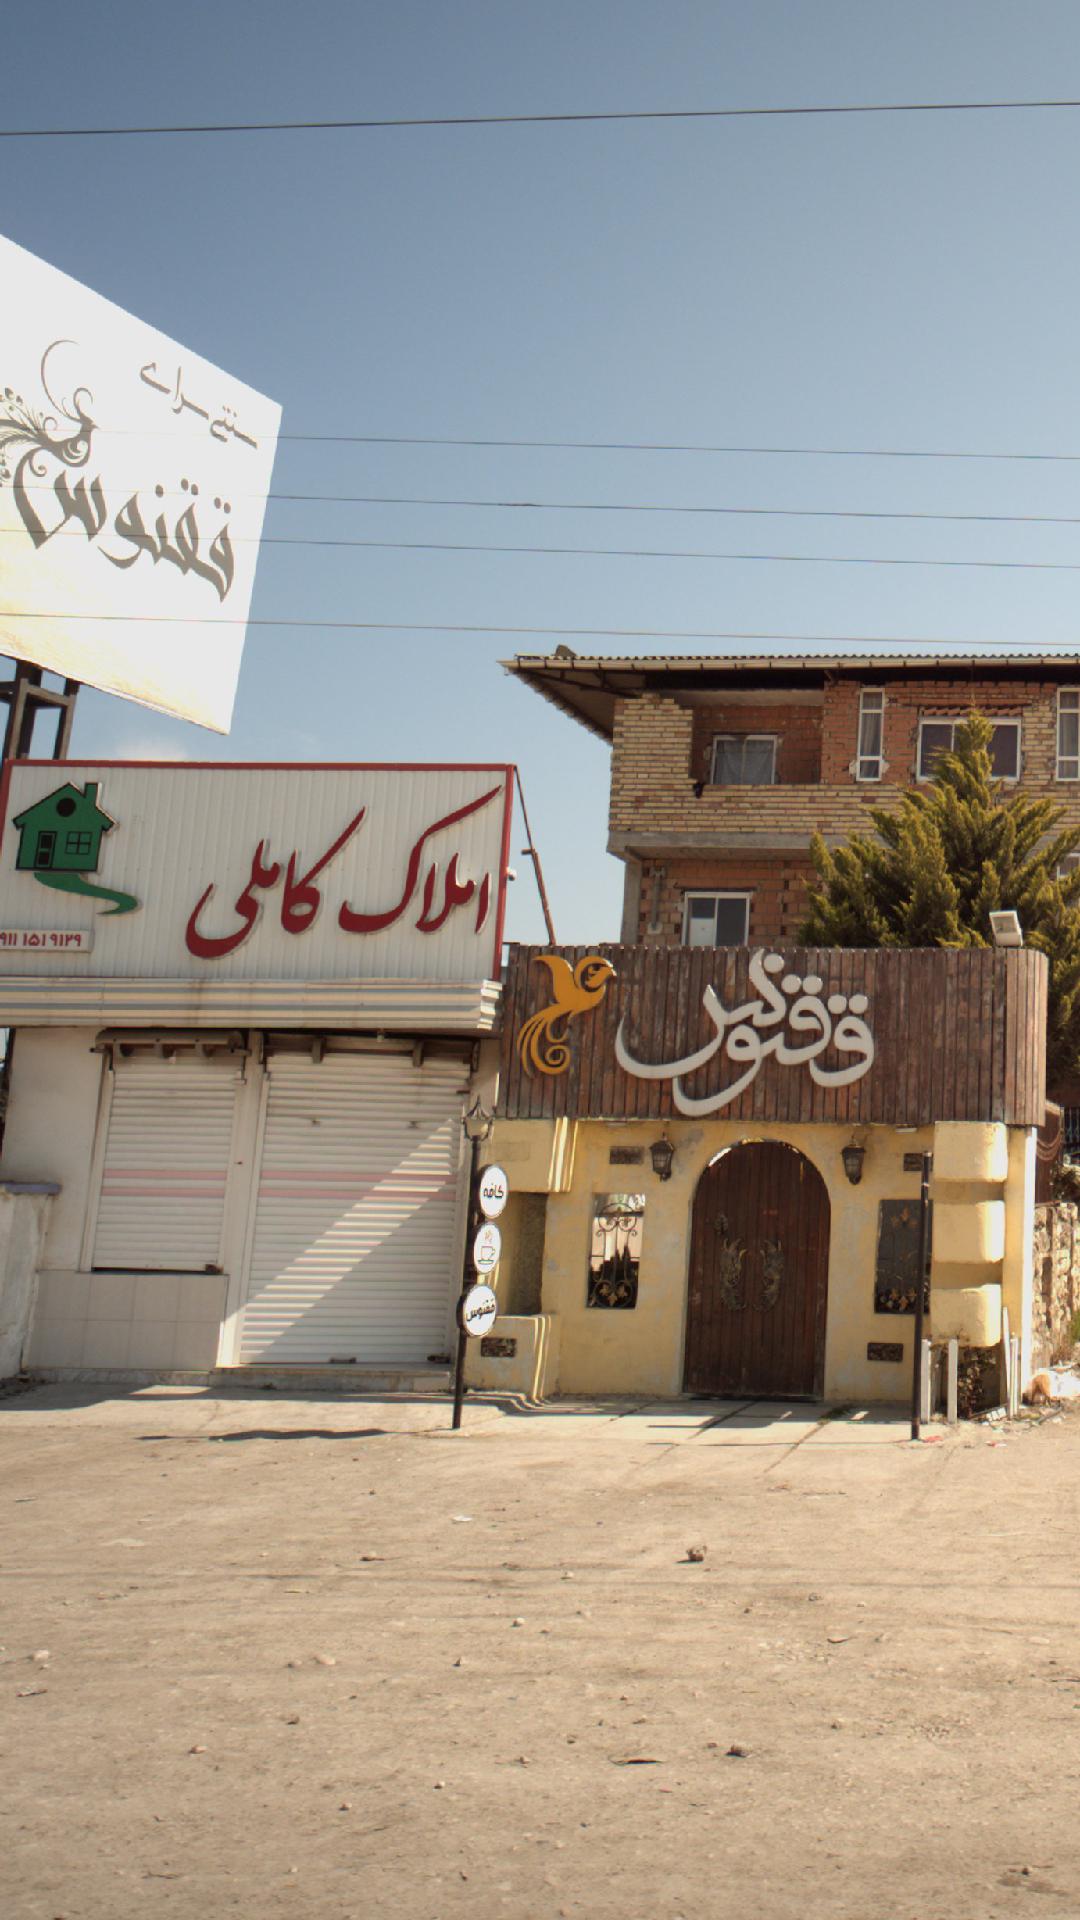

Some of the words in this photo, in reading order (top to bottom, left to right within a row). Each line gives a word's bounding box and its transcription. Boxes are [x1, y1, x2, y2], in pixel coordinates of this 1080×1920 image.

[13, 460, 235, 602] ققنوس
[185, 806, 367, 960] کاملی
[337, 784, 503, 934] املاک
[614, 948, 875, 1116] ققنوس
[483, 1182, 504, 1199] کافه
